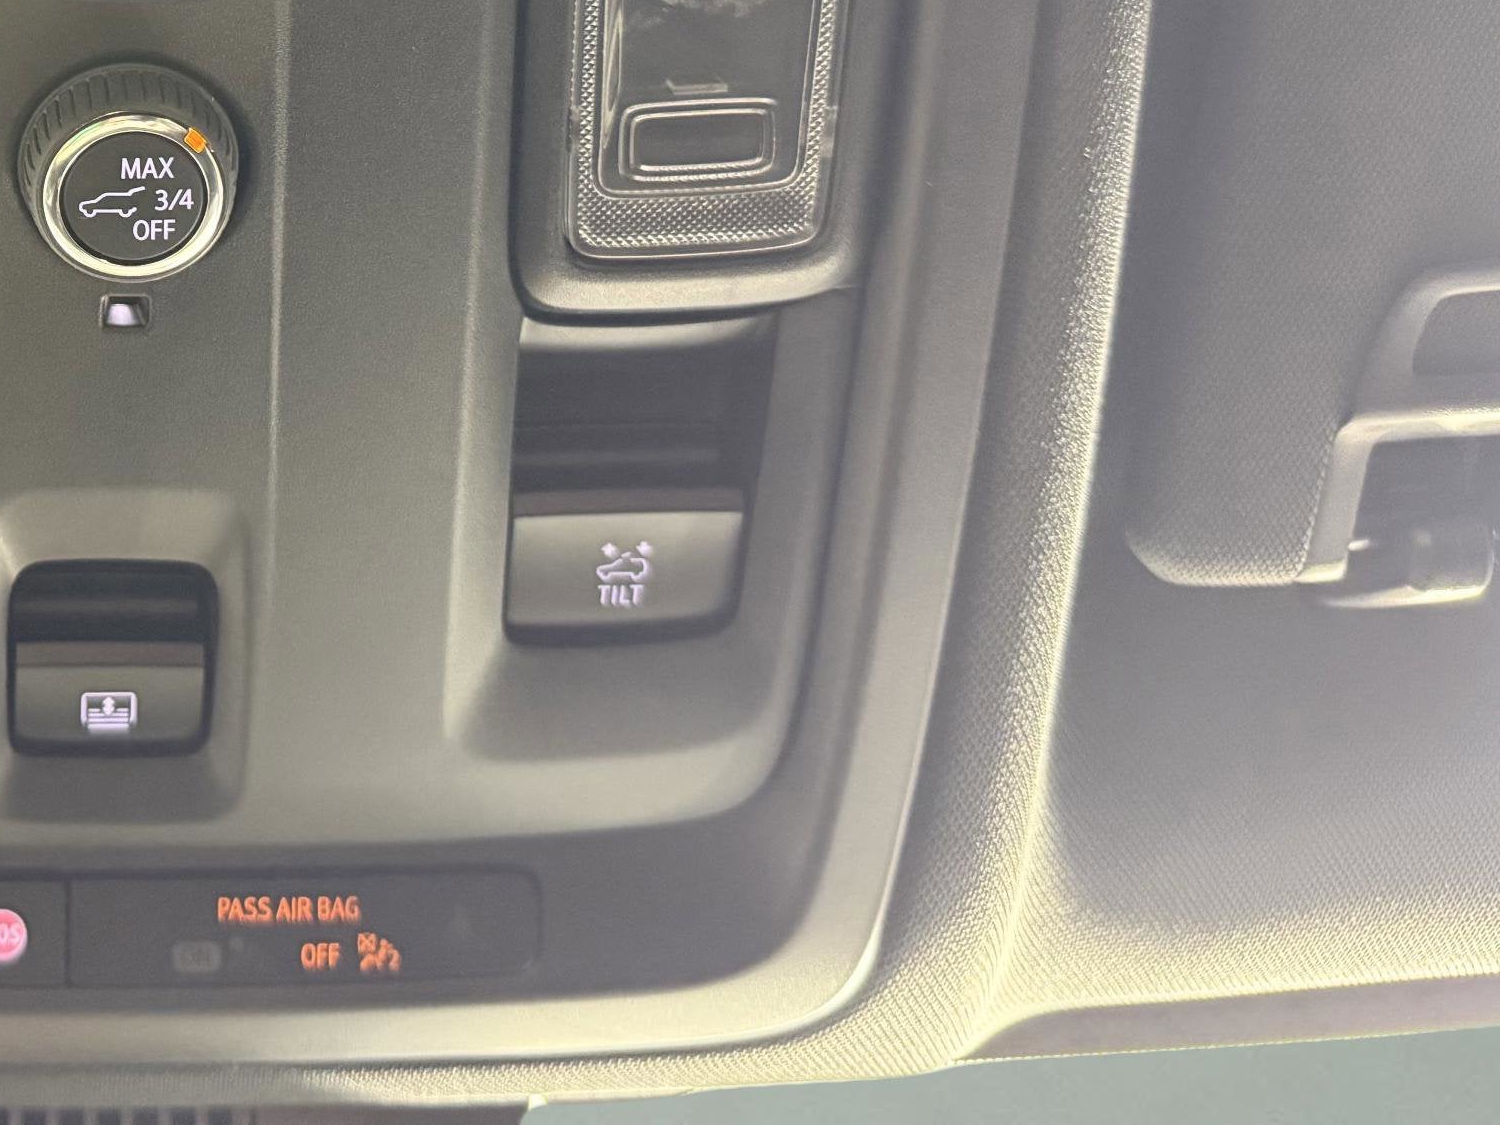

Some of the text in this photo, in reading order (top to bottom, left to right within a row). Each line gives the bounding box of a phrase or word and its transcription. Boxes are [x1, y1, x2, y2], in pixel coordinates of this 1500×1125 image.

[120, 157, 175, 179] MAX
[154, 189, 194, 210] 3/4
[132, 219, 176, 241] OFF
[597, 584, 644, 607] TILT
[217, 896, 361, 923] PASS AIR BAG
[300, 943, 341, 970] OFF
